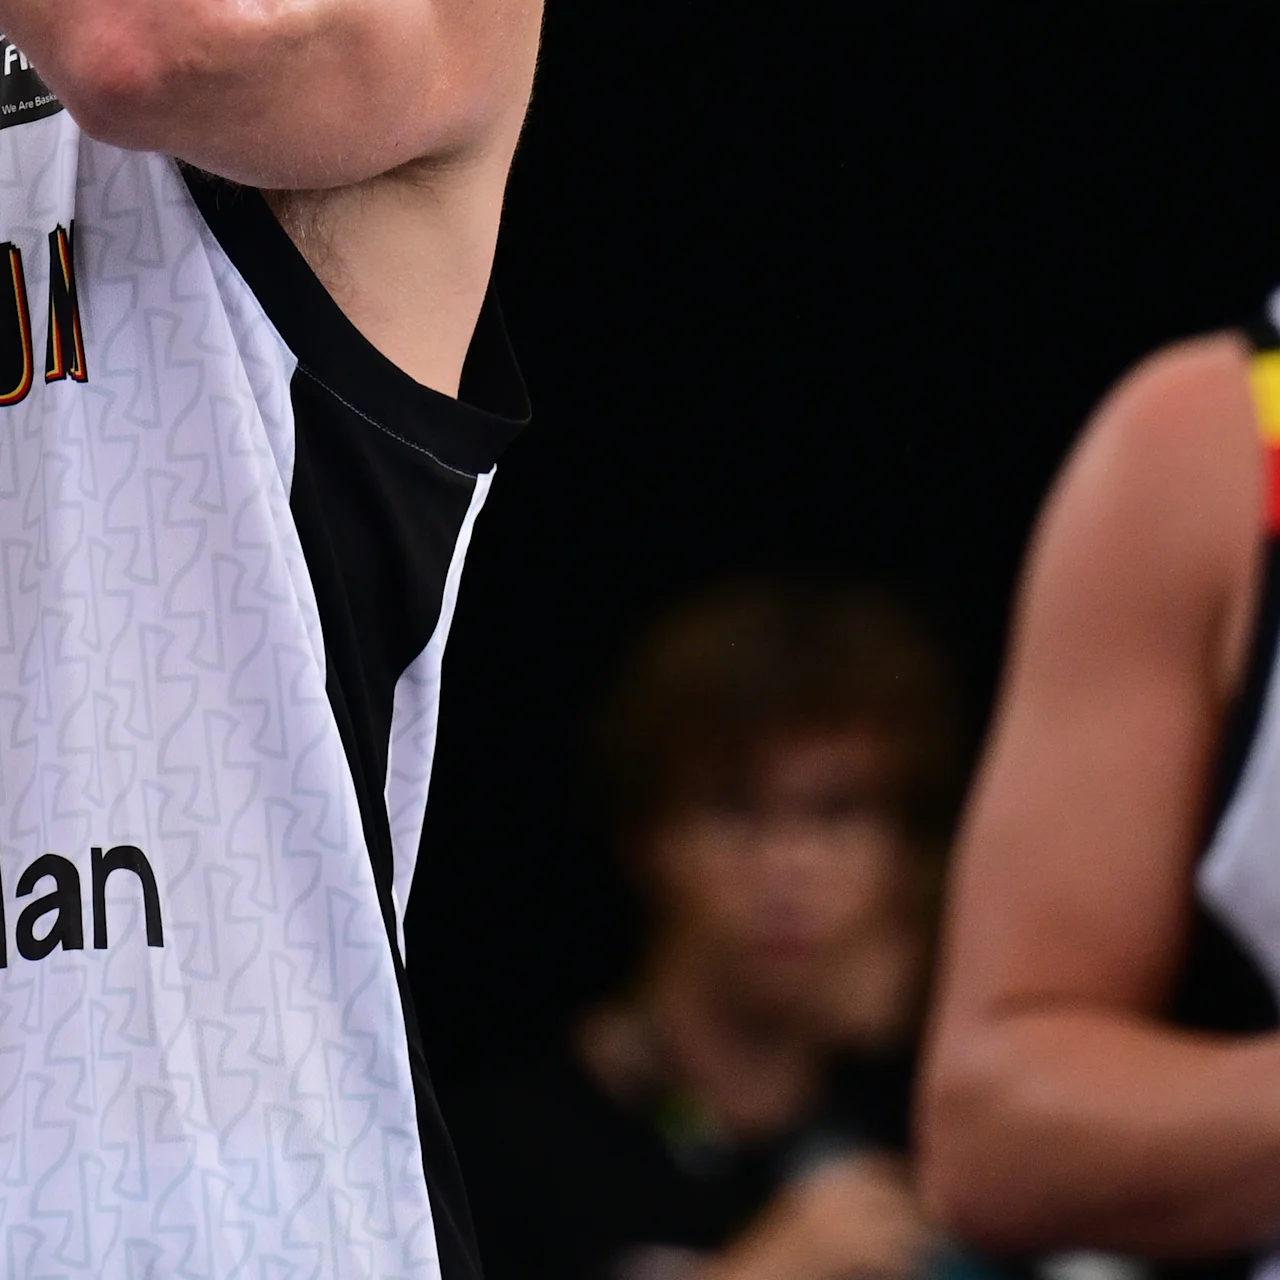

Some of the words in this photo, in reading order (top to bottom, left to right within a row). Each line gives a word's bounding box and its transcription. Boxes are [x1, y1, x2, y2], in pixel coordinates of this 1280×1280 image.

[4, 44, 35, 76] FI
[1, 104, 17, 115] We
[18, 100, 34, 111] Are
